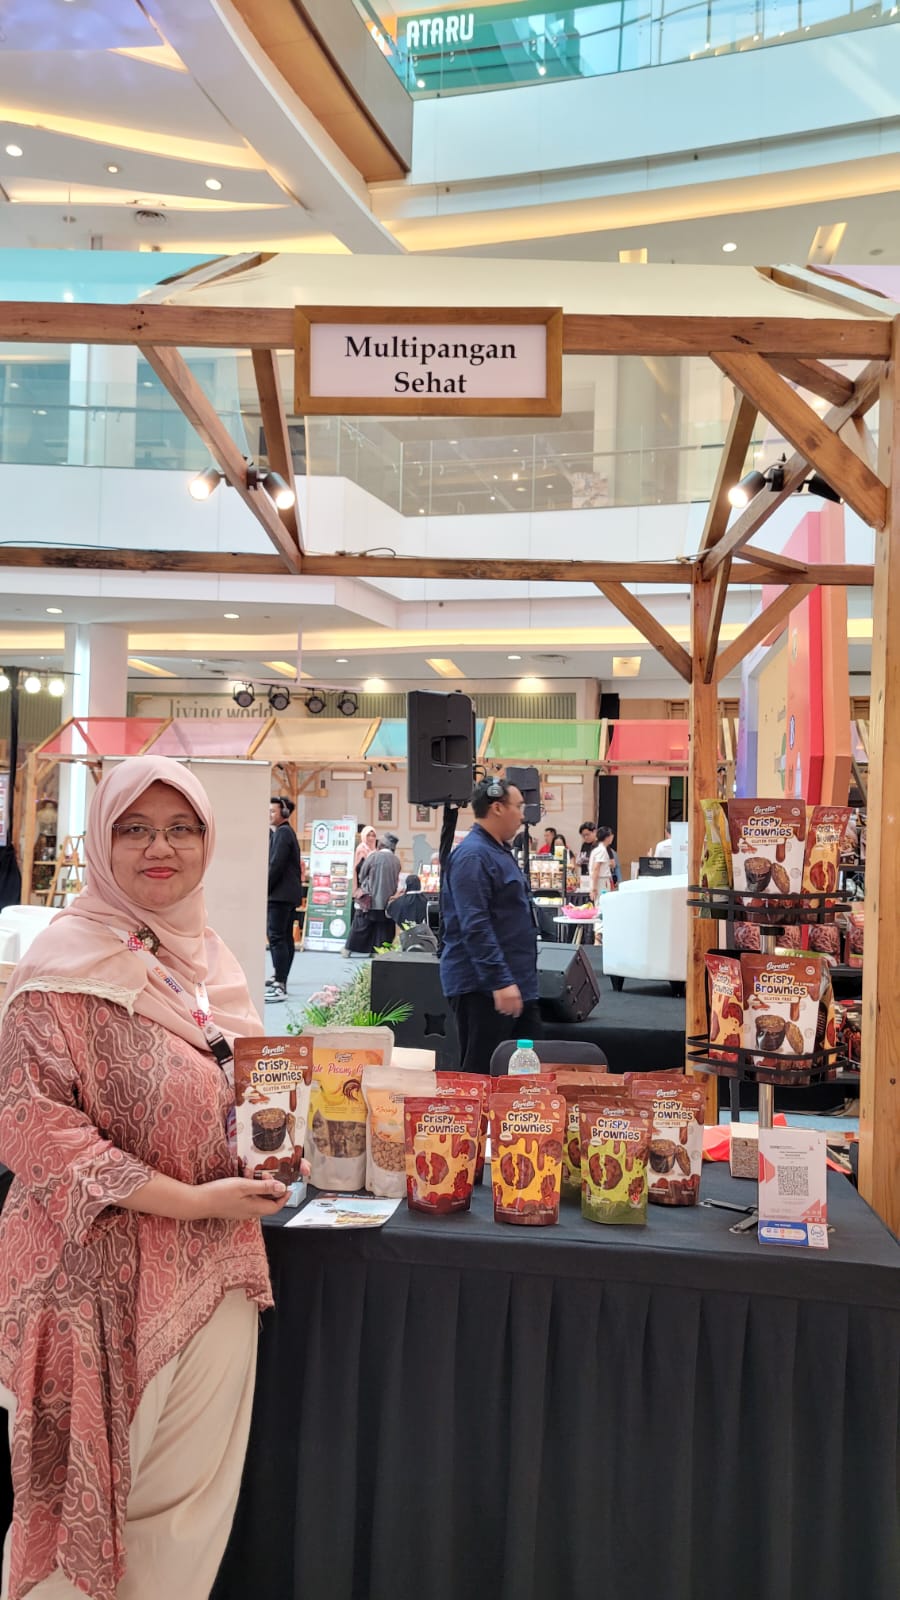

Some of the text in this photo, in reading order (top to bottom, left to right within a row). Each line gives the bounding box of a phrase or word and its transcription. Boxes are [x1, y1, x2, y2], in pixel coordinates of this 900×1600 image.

[406, 13, 475, 48] ATARU
[344, 335, 518, 366] Multipangan
[394, 371, 468, 394] Sehat
[749, 817, 781, 827] Crispy
[743, 827, 792, 837] Brownies
[761, 974, 794, 985] Crispy
[755, 983, 807, 996] Brownies
[257, 1059, 290, 1071] Crispy
[252, 1071, 303, 1084] Brownies
[423, 1114, 454, 1124] Crispy
[507, 1112, 540, 1123] Crispy
[653, 1110, 693, 1120] rownies
[417, 1123, 465, 1133] Brownies
[502, 1122, 552, 1133] Brownies
[597, 1119, 629, 1130] Crispy
[592, 1128, 640, 1140] Brownies
